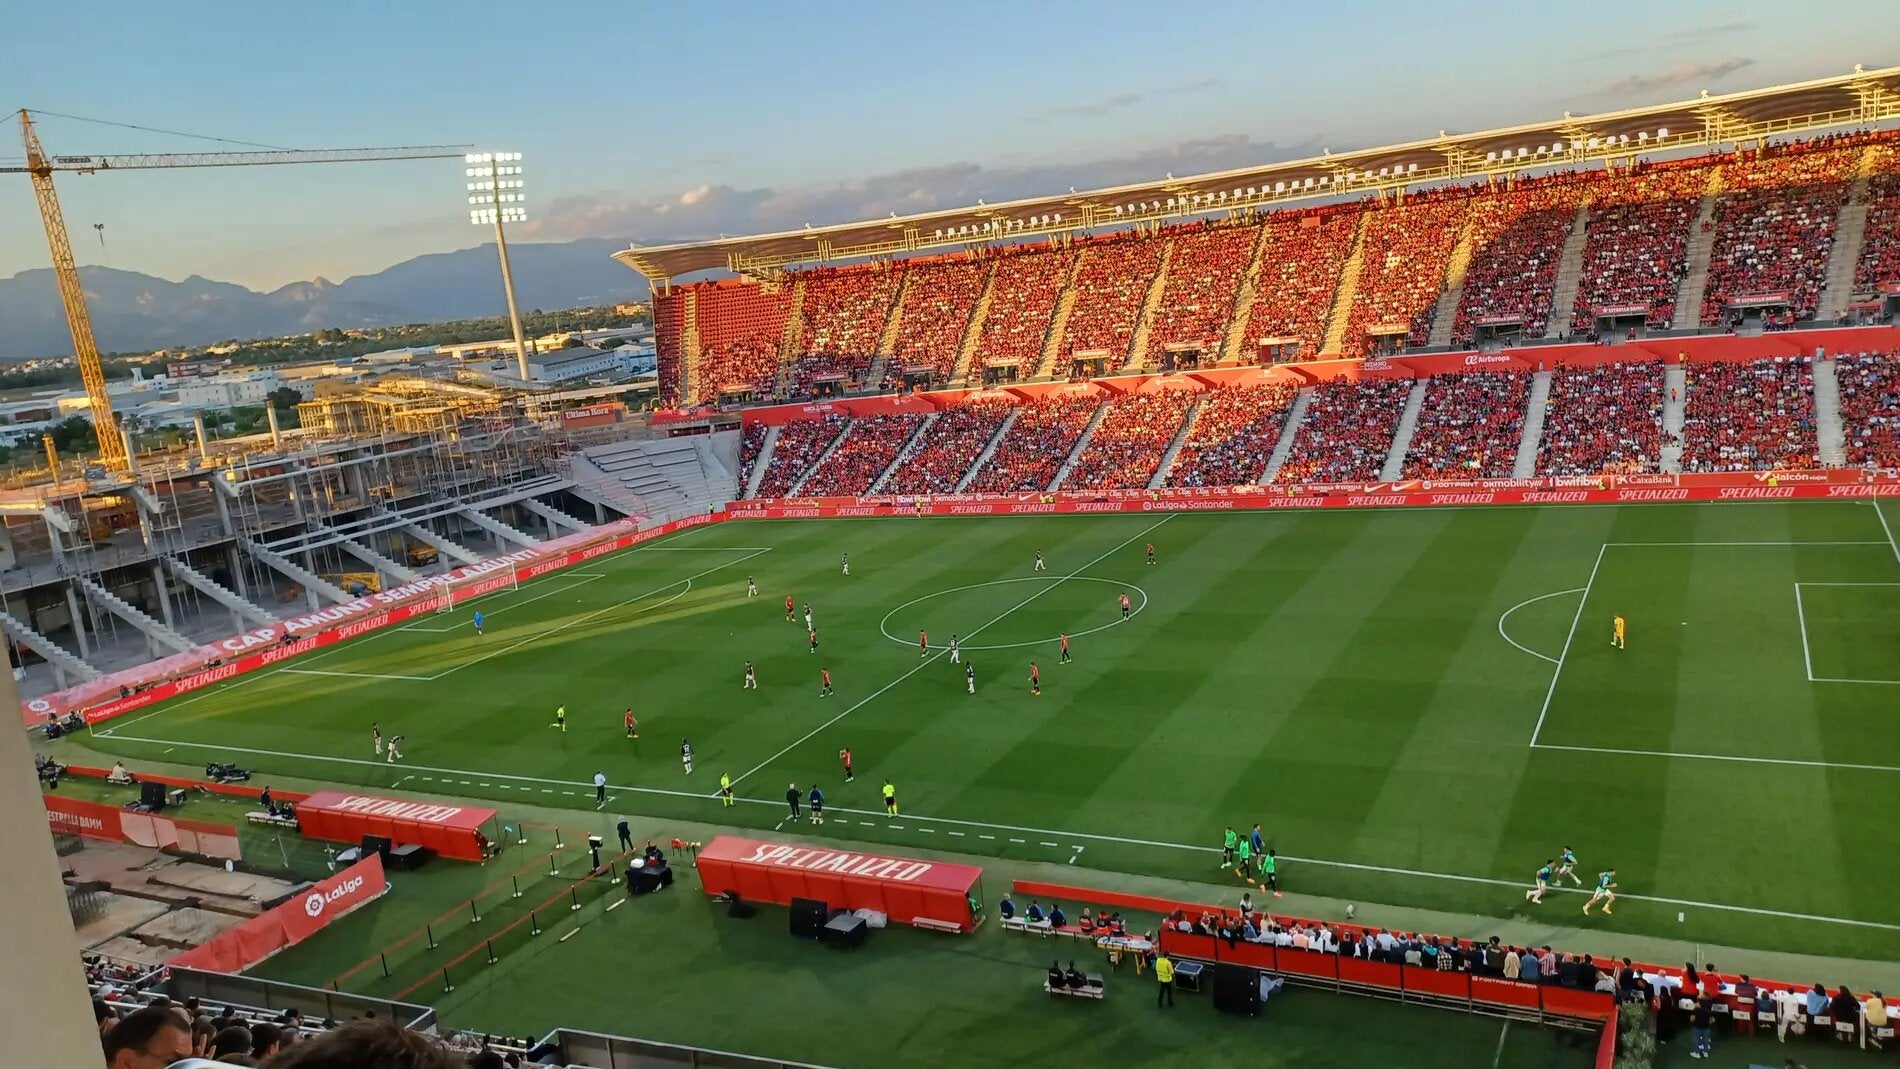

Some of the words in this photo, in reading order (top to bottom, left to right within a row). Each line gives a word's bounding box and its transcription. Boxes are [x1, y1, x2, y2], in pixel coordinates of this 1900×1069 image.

[1629, 476, 1672, 485] CaixaBank
[1520, 491, 1589, 502] SPECIALIZED
[1617, 488, 1688, 500] SPECIALIZED
[1718, 486, 1795, 498] SPECIALIZED
[1152, 502, 1179, 510] LaLiga
[1188, 500, 1234, 510] Santander
[1268, 497, 1324, 508] SPECIALIZED
[1348, 496, 1406, 506] SPECIALIZED
[1430, 494, 1494, 504] SPECIALIZED
[782, 508, 820, 517] SPECIALIZED
[836, 508, 874, 516] SPECIALIZED
[950, 506, 992, 514] SPECIALIZED
[1010, 504, 1056, 513] SPECIALIZED
[1074, 502, 1122, 512] SPECIALIZED
[729, 510, 768, 519] SPECIALIZED
[675, 514, 712, 530] SPECIALIZED
[630, 526, 664, 544] SPECIALIZED
[582, 541, 618, 560] SPECIALIZED
[530, 556, 568, 576] SPECIALIZED
[222, 628, 276, 650] CAP
[284, 598, 373, 634] AMUNT
[374, 572, 456, 604] SEMPRE
[338, 614, 389, 640] SPECIALIZED
[261, 637, 316, 665] SPECIALIZED
[174, 663, 238, 694] SPECIALIZED
[47, 810, 80, 826] ESTRELLA
[80, 816, 102, 830] DAMM
[740, 844, 932, 881] SPECIALIZED
[324, 875, 364, 904] LaLiga
